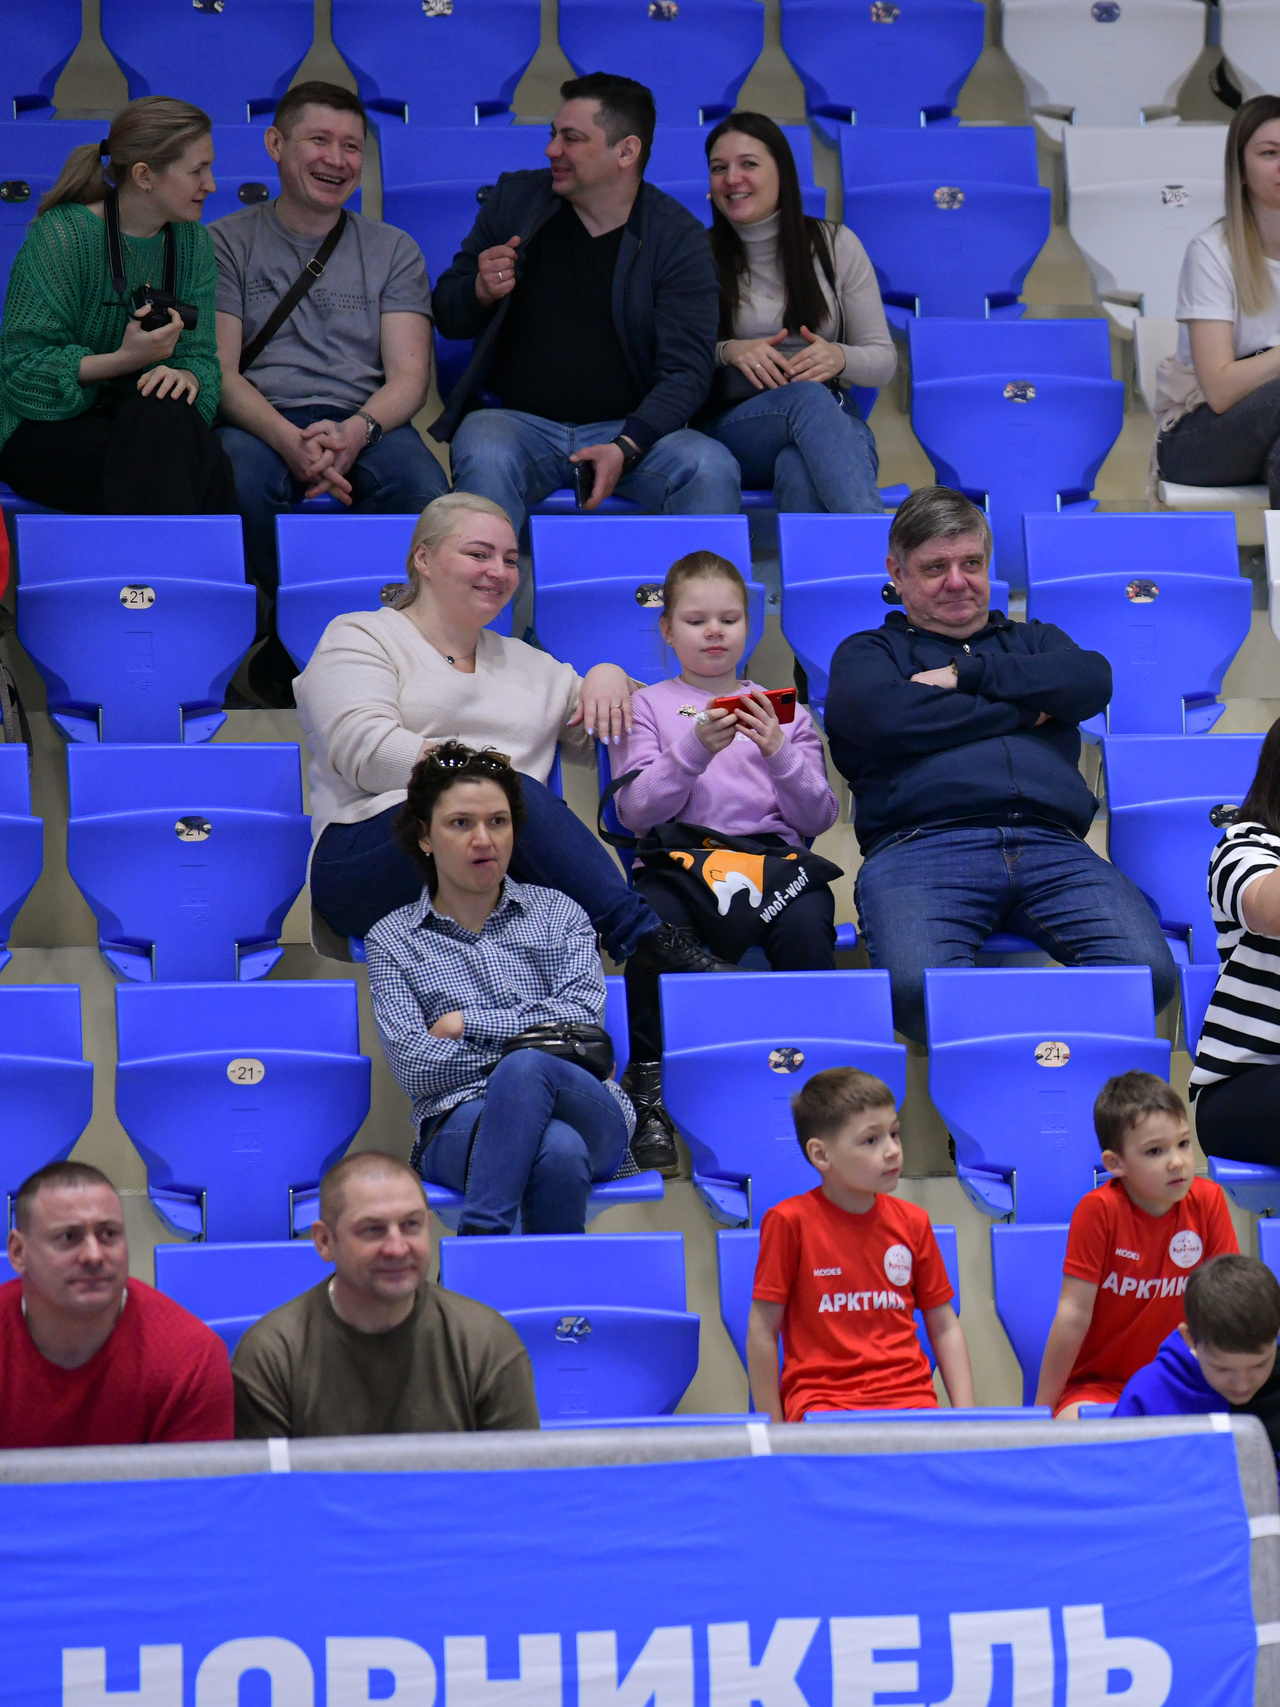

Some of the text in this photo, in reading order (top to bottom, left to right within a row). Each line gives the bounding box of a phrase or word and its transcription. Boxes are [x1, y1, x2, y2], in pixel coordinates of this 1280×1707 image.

[1166, 190, 1182, 203] 26
[129, 590, 146, 604] 21
[644, 589, 660, 602] 23
[1135, 585, 1150, 597] 25
[185, 823, 201, 836] 21
[760, 866, 809, 923] woof-woof
[1044, 1047, 1061, 1061] 24
[237, 1066, 254, 1080] 21
[1101, 1271, 1190, 1299] АРКТИК
